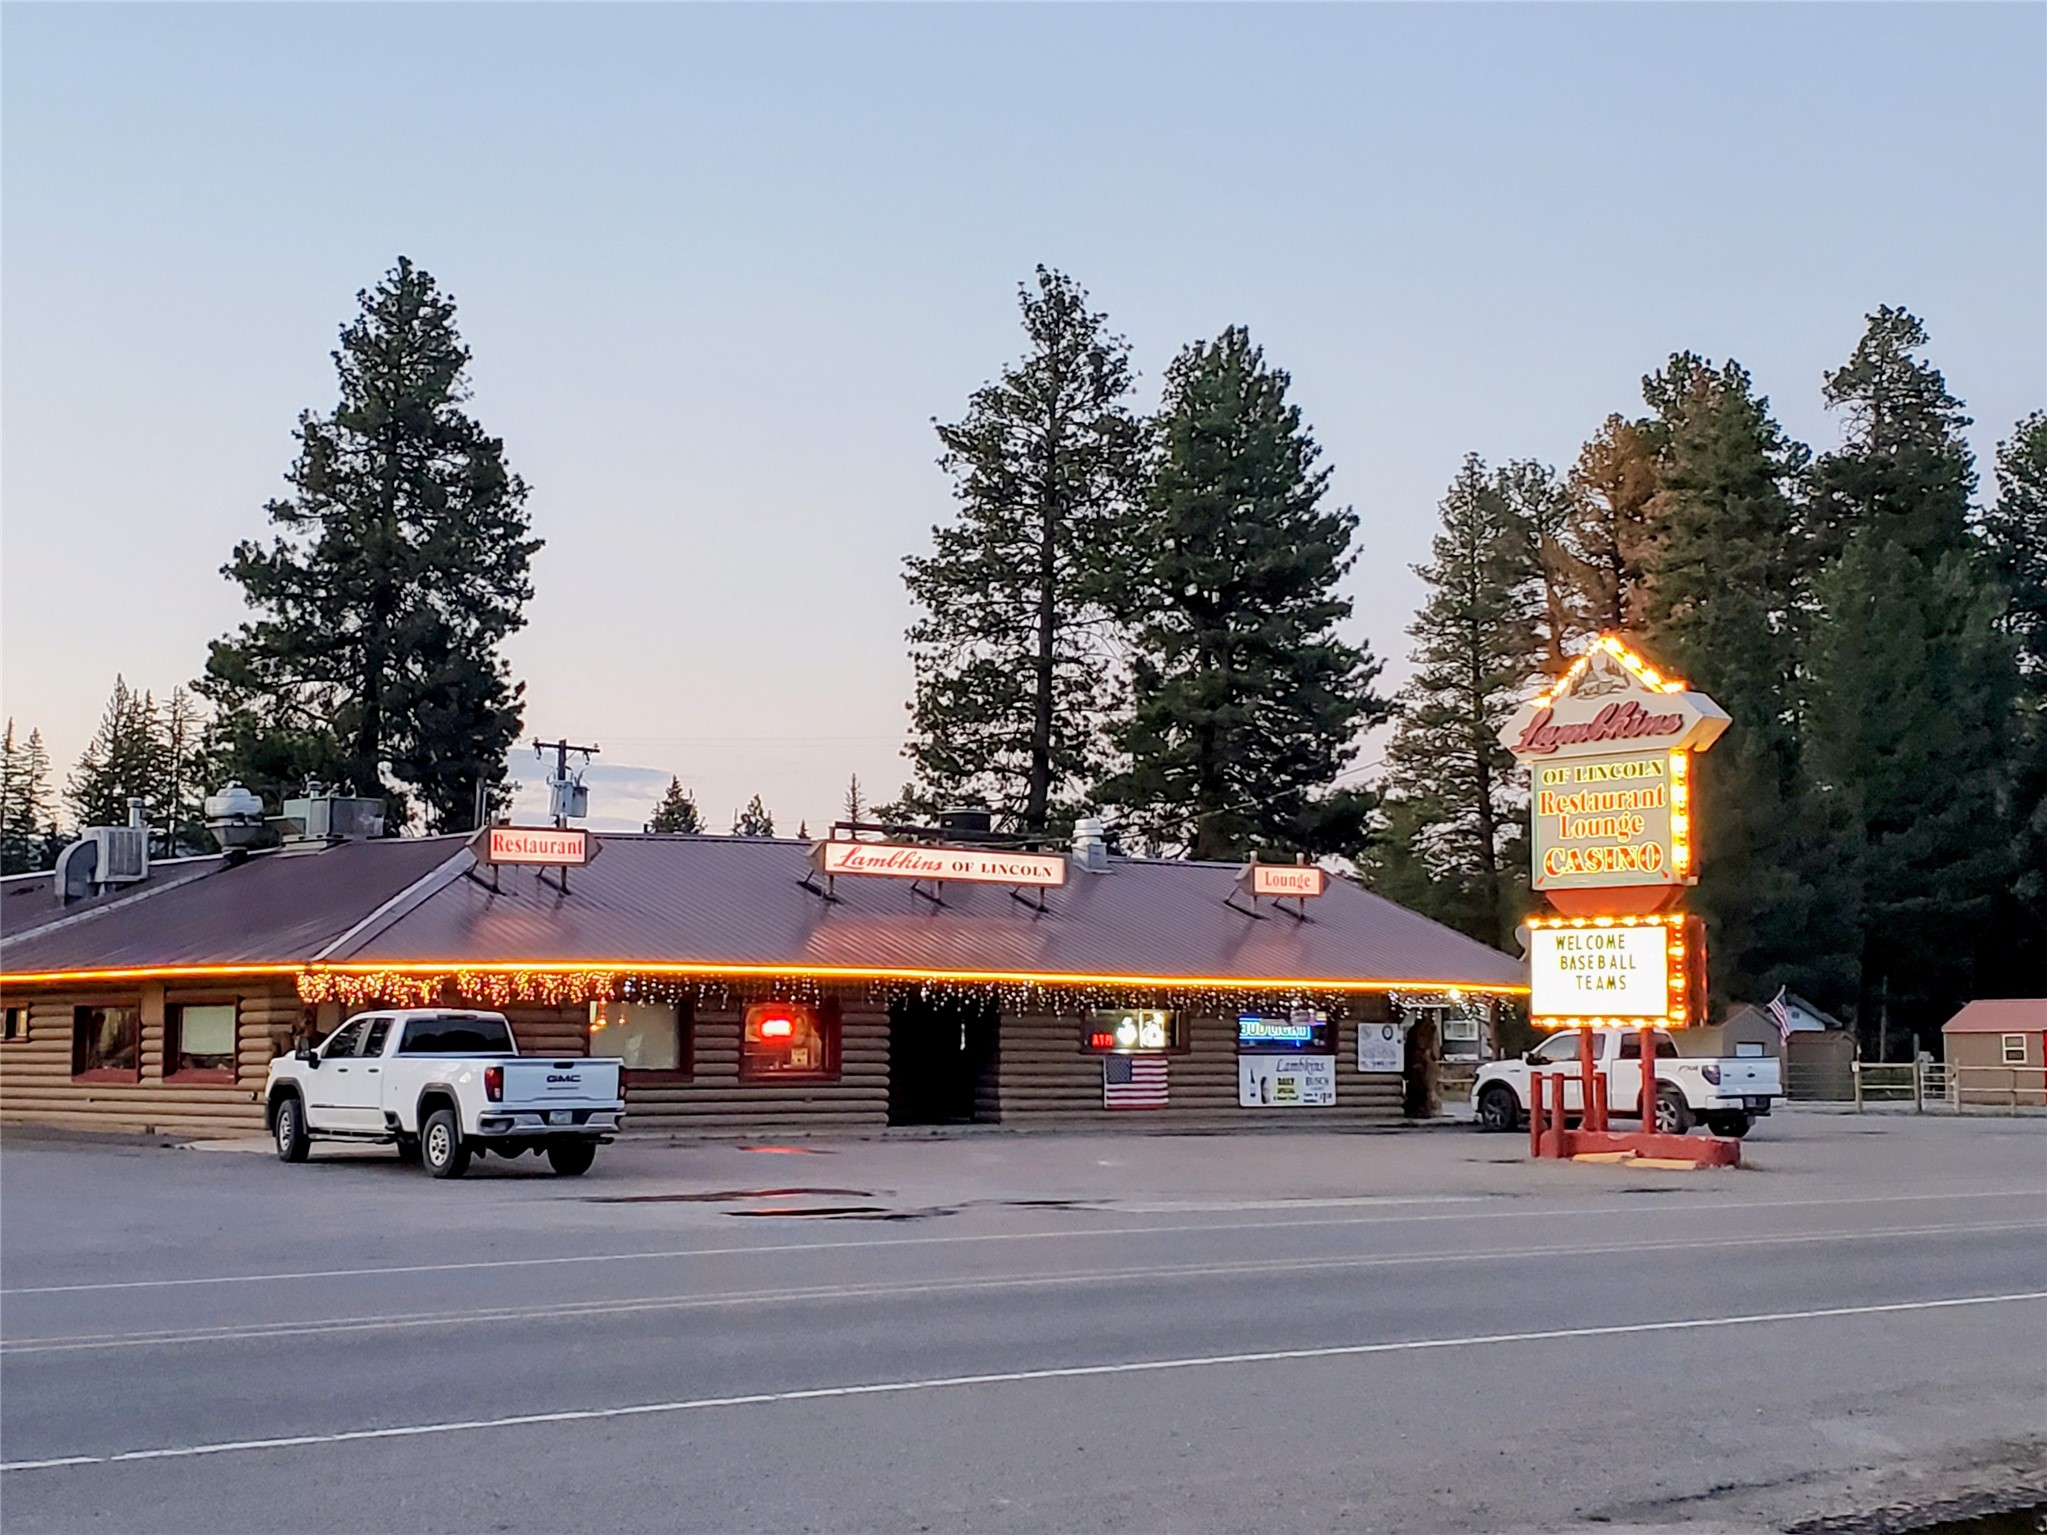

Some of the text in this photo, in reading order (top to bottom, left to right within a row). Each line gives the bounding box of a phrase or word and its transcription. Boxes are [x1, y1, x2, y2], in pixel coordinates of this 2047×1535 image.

[1512, 701, 1684, 753] Lambkins
[1543, 759, 1664, 786] OF LINCOLN
[1539, 783, 1666, 816] Restaurant
[1559, 811, 1645, 842] Lounge
[493, 834, 582, 855] Restaurant
[833, 846, 1053, 878] Lambkins OF LINCOLN
[1544, 841, 1664, 877] CASINO
[1265, 871, 1312, 889] Lounge
[1555, 934, 1625, 950] WELCOME
[1560, 954, 1636, 970] BASEBALL
[1576, 975, 1627, 990] TEAMS
[546, 1075, 582, 1083] GMC
